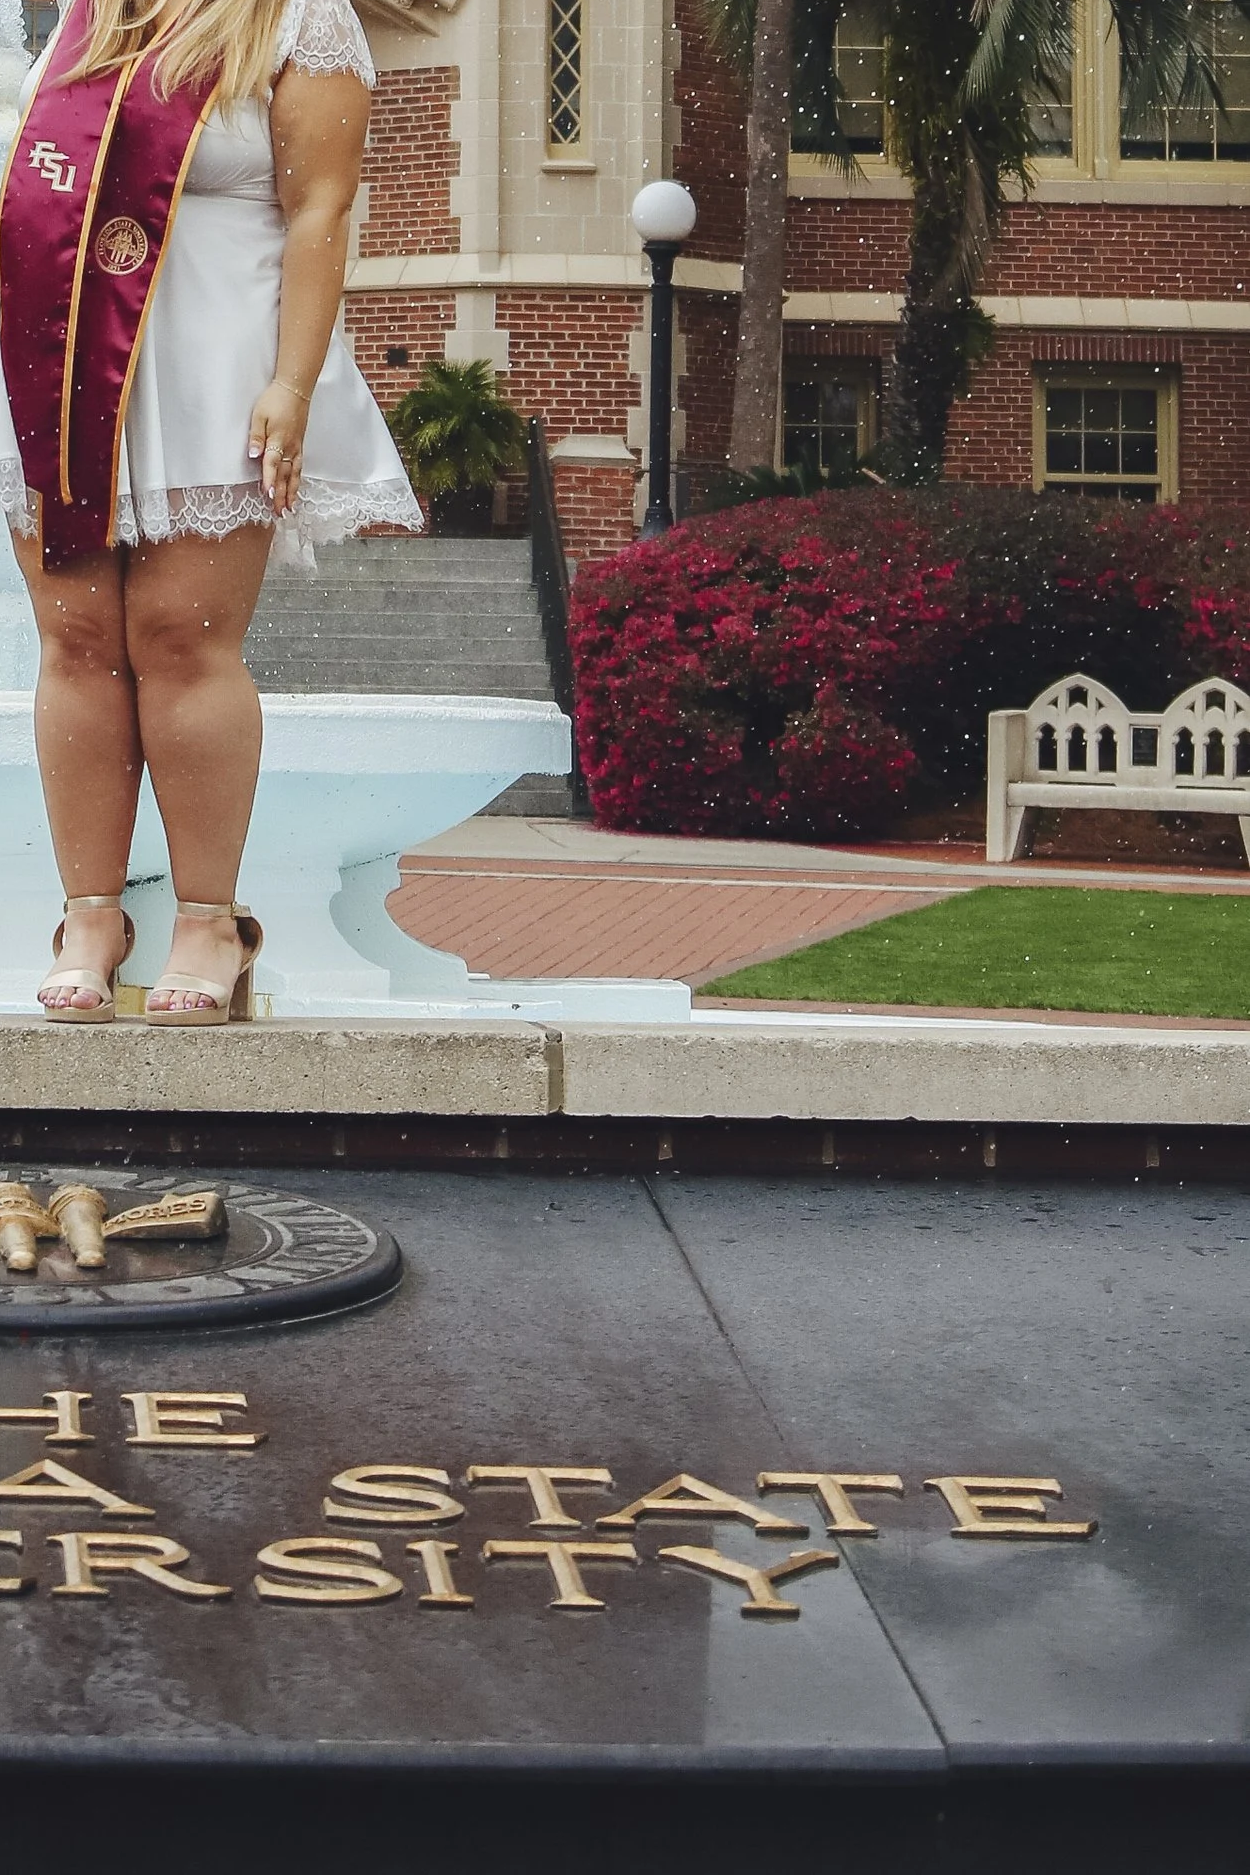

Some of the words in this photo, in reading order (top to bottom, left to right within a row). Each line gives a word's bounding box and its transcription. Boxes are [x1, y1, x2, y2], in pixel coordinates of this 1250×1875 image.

[28, 140, 77, 193] FSU
[104, 1199, 208, 1229] MORES
[122, 1175, 368, 1295] UNIVERSITY
[322, 1465, 1098, 1537] STATE
